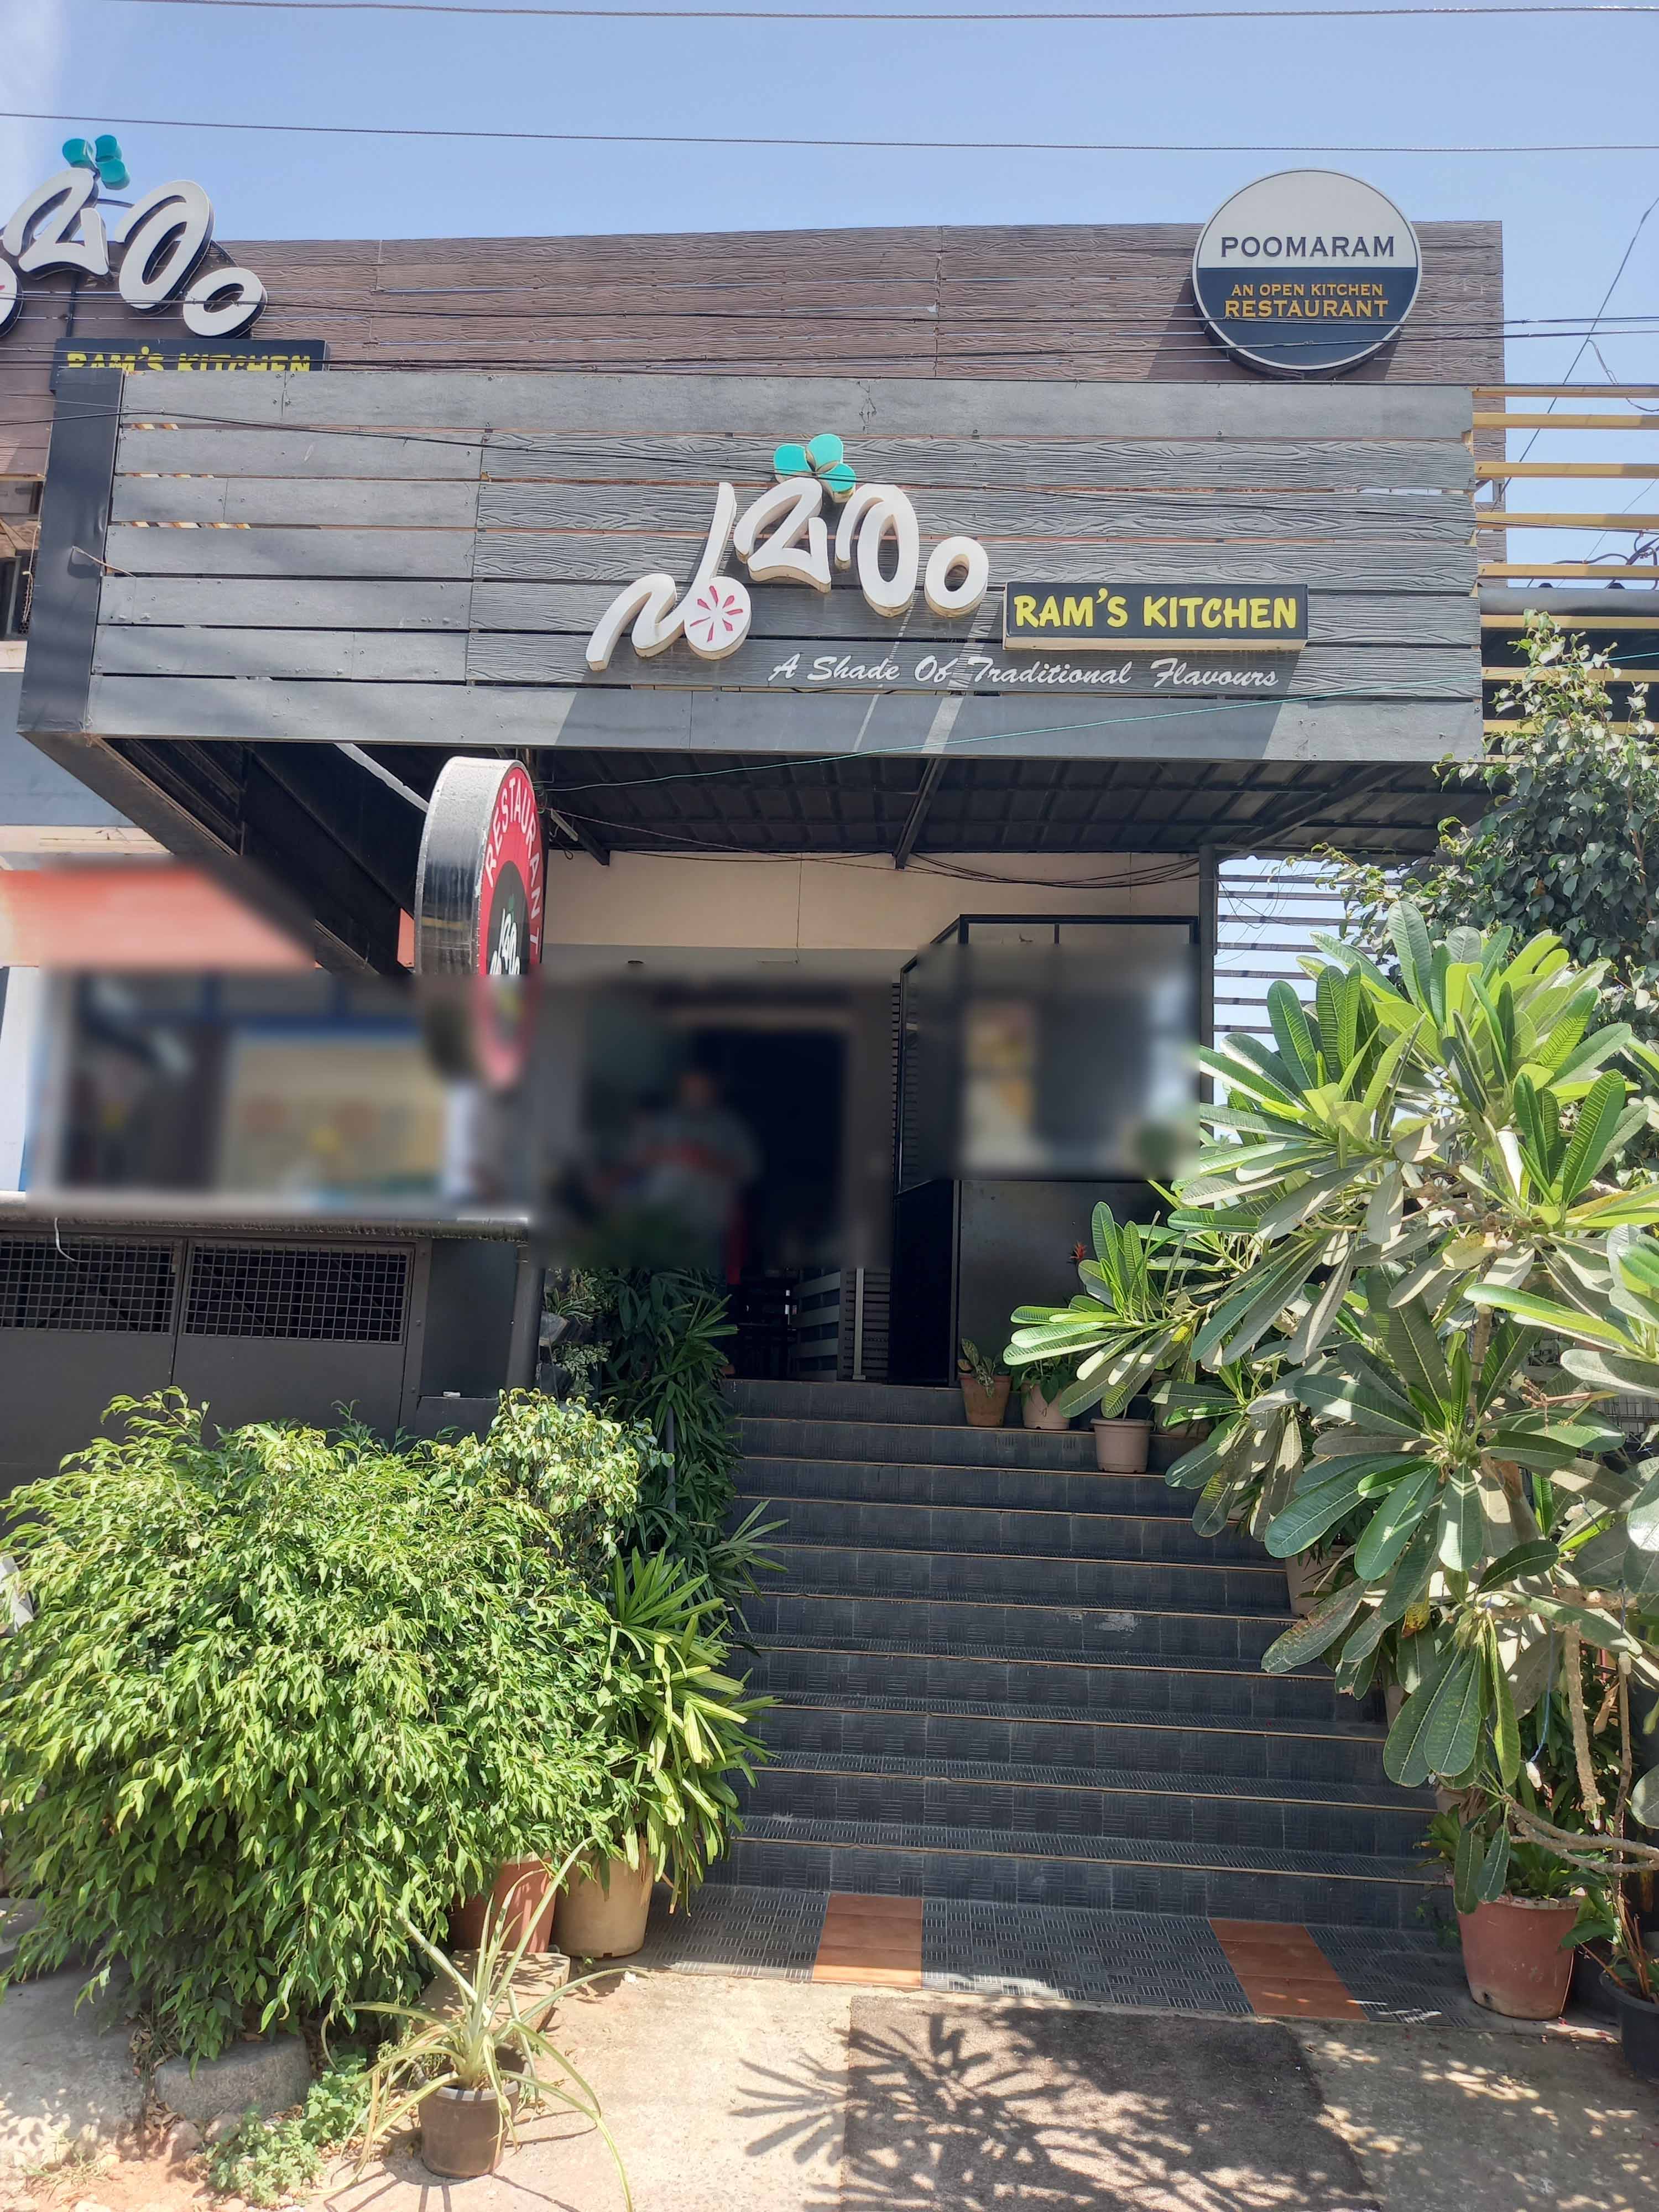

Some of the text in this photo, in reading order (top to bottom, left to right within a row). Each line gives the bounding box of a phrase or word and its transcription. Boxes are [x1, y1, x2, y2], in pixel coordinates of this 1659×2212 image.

[1220, 236, 1395, 258] POOMARAM
[1231, 284, 1384, 296] AN OPEN KITCHEN
[1224, 300, 1389, 319] RESTAURANT
[1013, 587, 1297, 629] RAM'S KITCHEN
[768, 653, 1279, 687] A Shade Of Traditional Flavours
[485, 777, 541, 955] RESTAURANT
